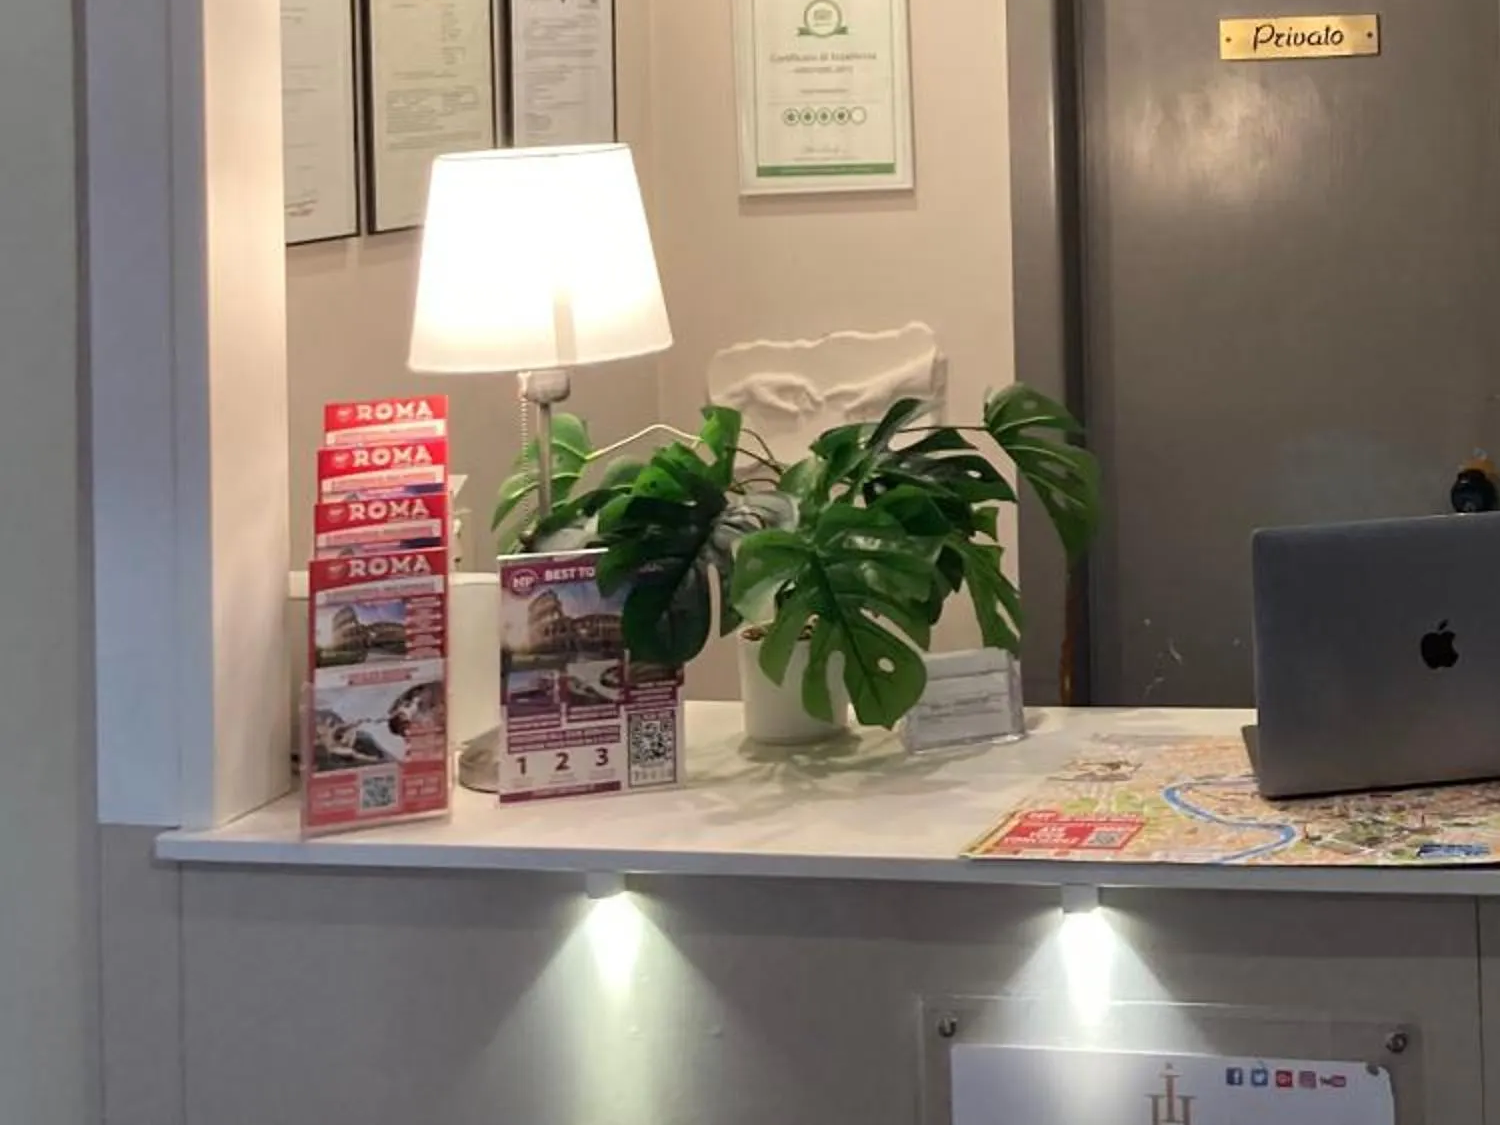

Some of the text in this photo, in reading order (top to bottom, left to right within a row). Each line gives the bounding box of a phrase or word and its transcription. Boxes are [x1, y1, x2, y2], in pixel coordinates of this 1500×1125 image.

[356, 400, 433, 420] ROMA
[352, 445, 433, 466] ROMA
[348, 499, 429, 520] ROMA
[348, 555, 431, 577] ROMA
[545, 569, 575, 581] BEST
[516, 748, 609, 774] 1 2 3
